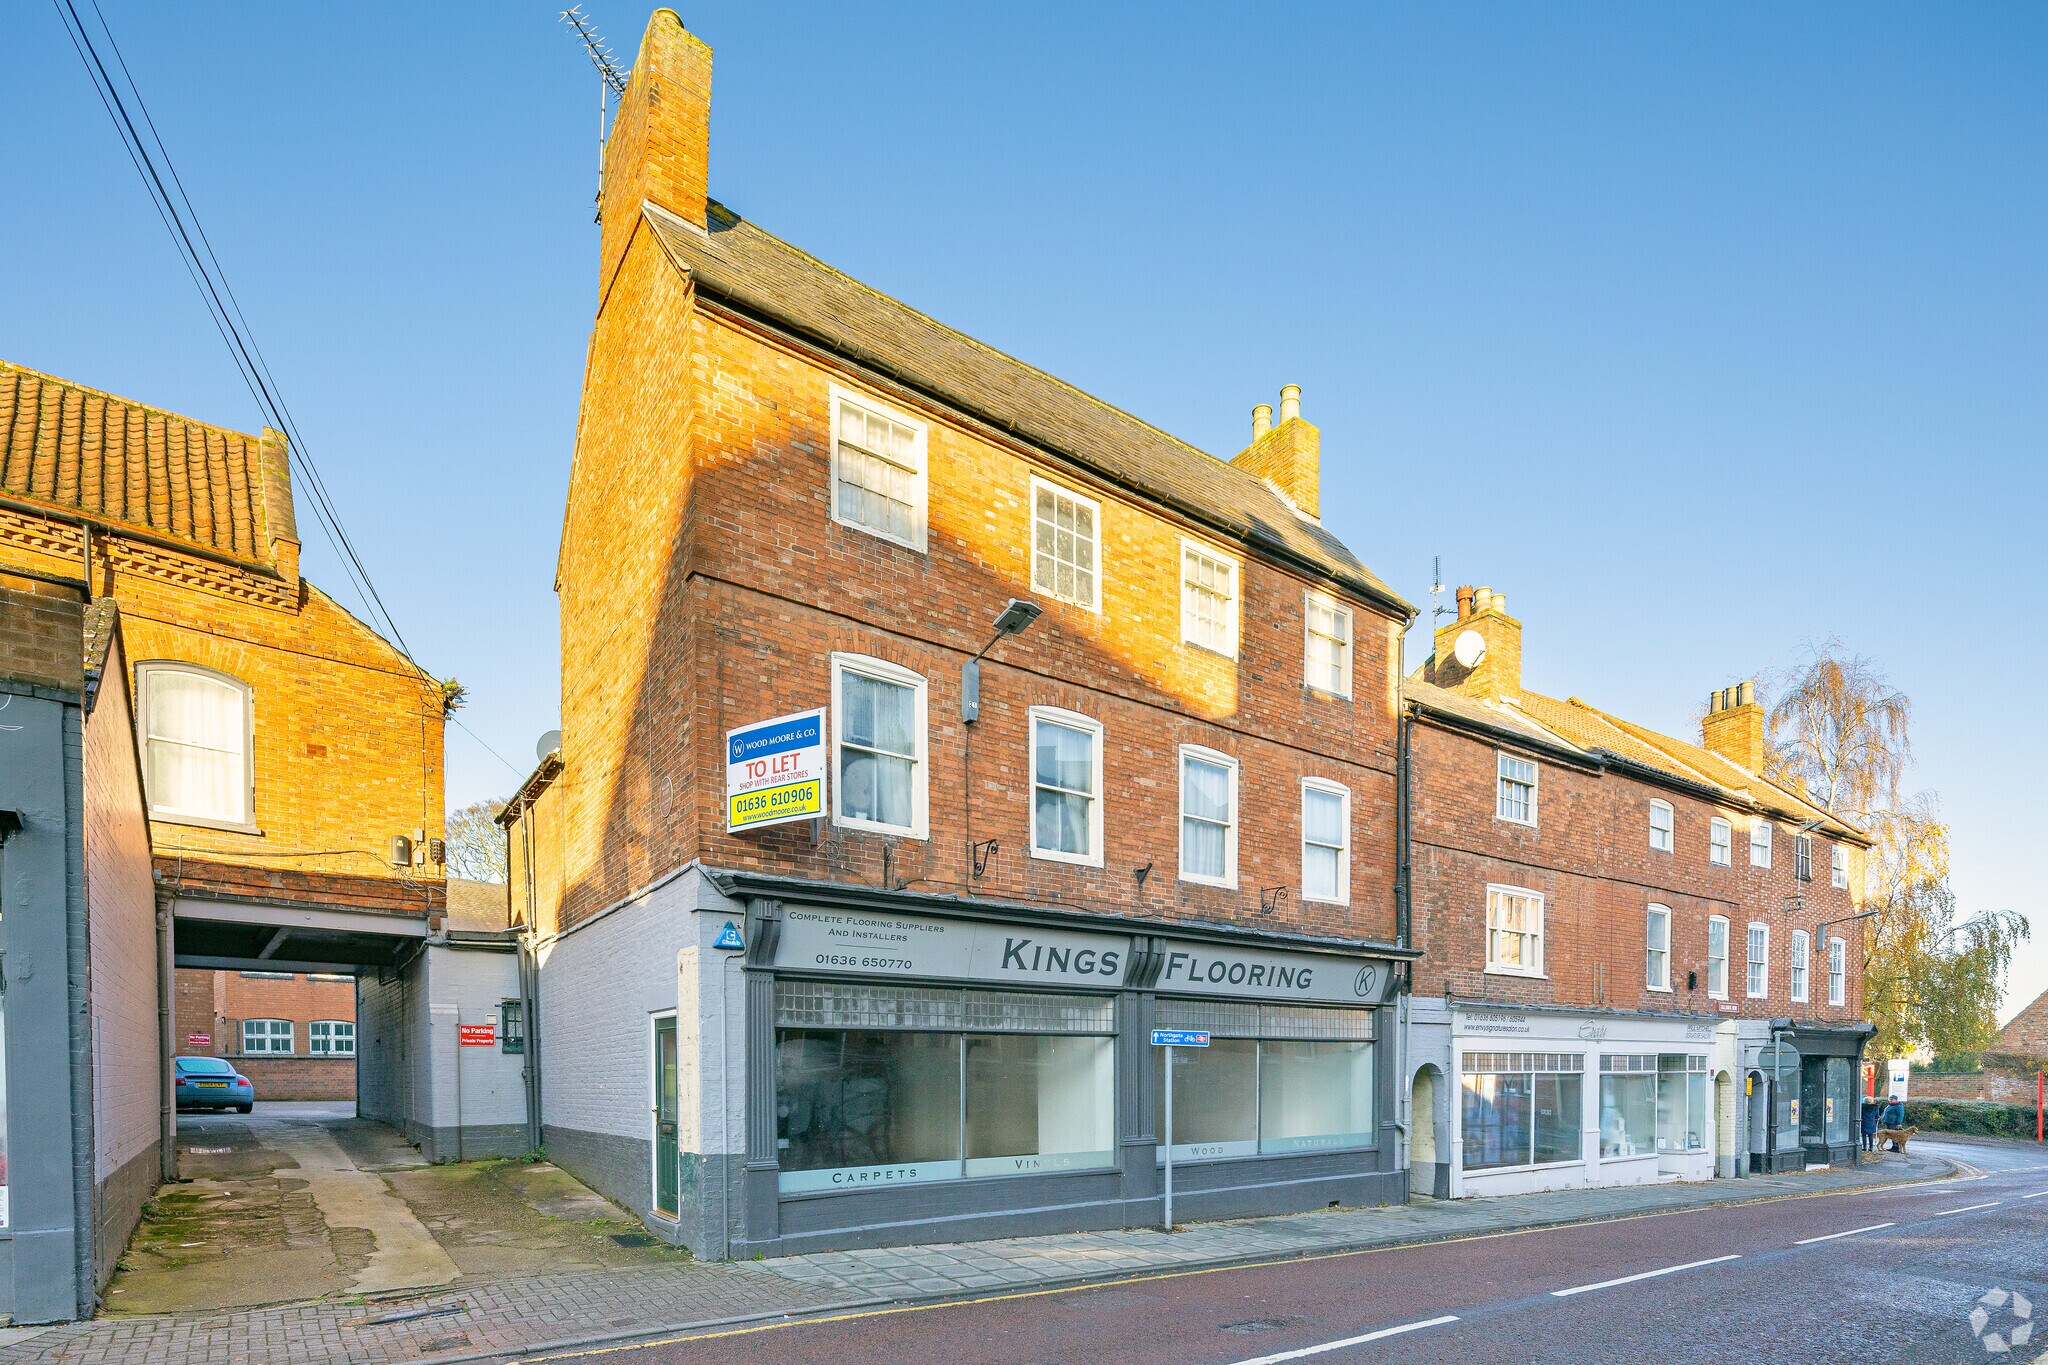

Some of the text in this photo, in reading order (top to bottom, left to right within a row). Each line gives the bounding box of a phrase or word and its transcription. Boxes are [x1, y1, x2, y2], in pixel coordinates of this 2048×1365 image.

[746, 728, 817, 750] WOOD MOORE & CO.
[746, 752, 801, 779] TO LET
[739, 770, 809, 791] SHOP WITH REAR STORES
[736, 787, 813, 813] 01636 610906
[742, 804, 807, 821] www.woodmoore.co.uk
[789, 911, 945, 933] COMPLETE FLOORING SUPPLIERS
[852, 930, 908, 942] INSTALLERS
[815, 954, 913, 970] 01636 650770
[1001, 937, 1314, 990] KINGS FLOORING
[471, 1027, 494, 1035] Parking
[1191, 1146, 1224, 1156] WOOD
[832, 1169, 917, 1184] CARPETS
